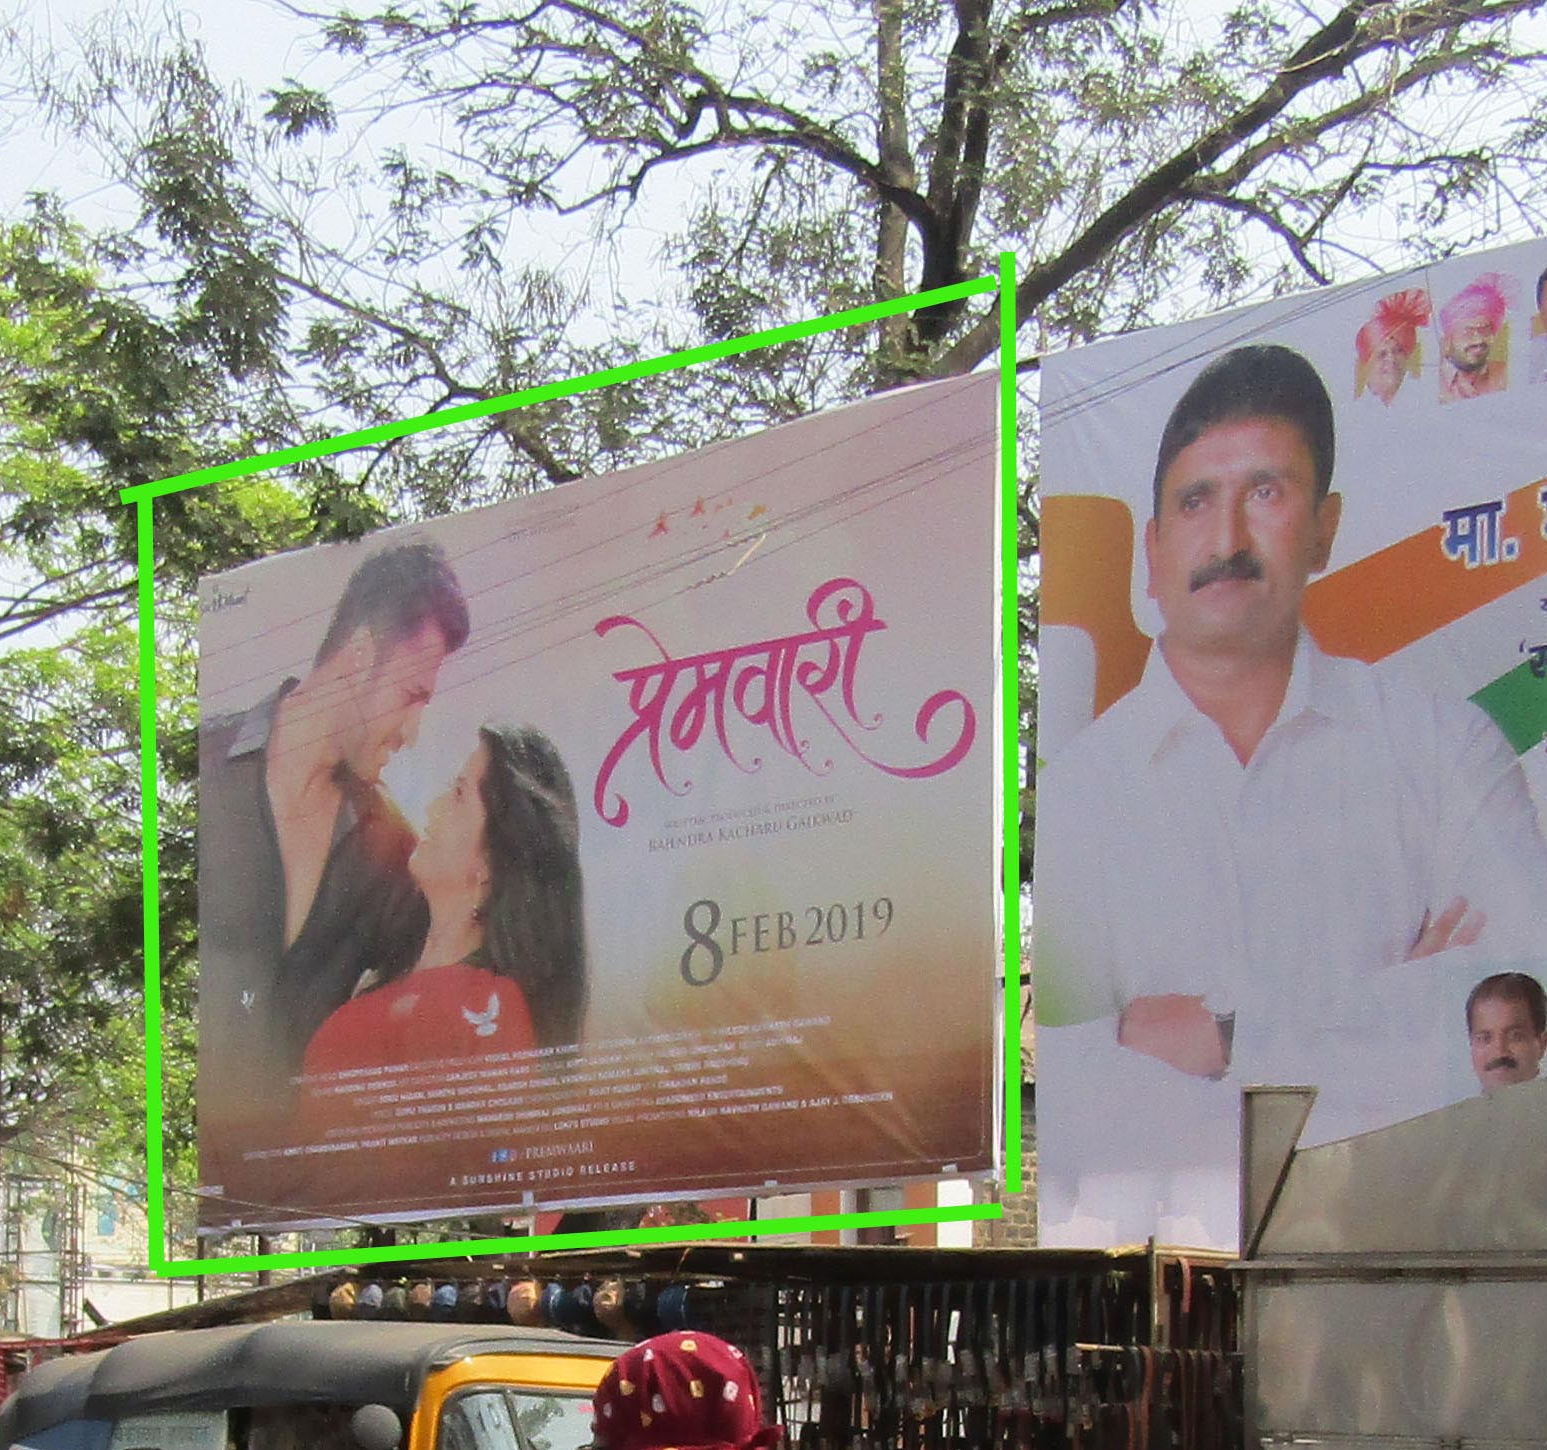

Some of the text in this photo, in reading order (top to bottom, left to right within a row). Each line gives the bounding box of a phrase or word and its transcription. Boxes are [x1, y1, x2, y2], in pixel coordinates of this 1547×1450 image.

[1442, 500, 1518, 564] मा.
[594, 578, 976, 828] प्रेमवारी
[786, 809, 855, 831] GAIKWAD
[681, 897, 893, 987] 8 FEB 2019
[580, 1160, 637, 1176] RELEASE
